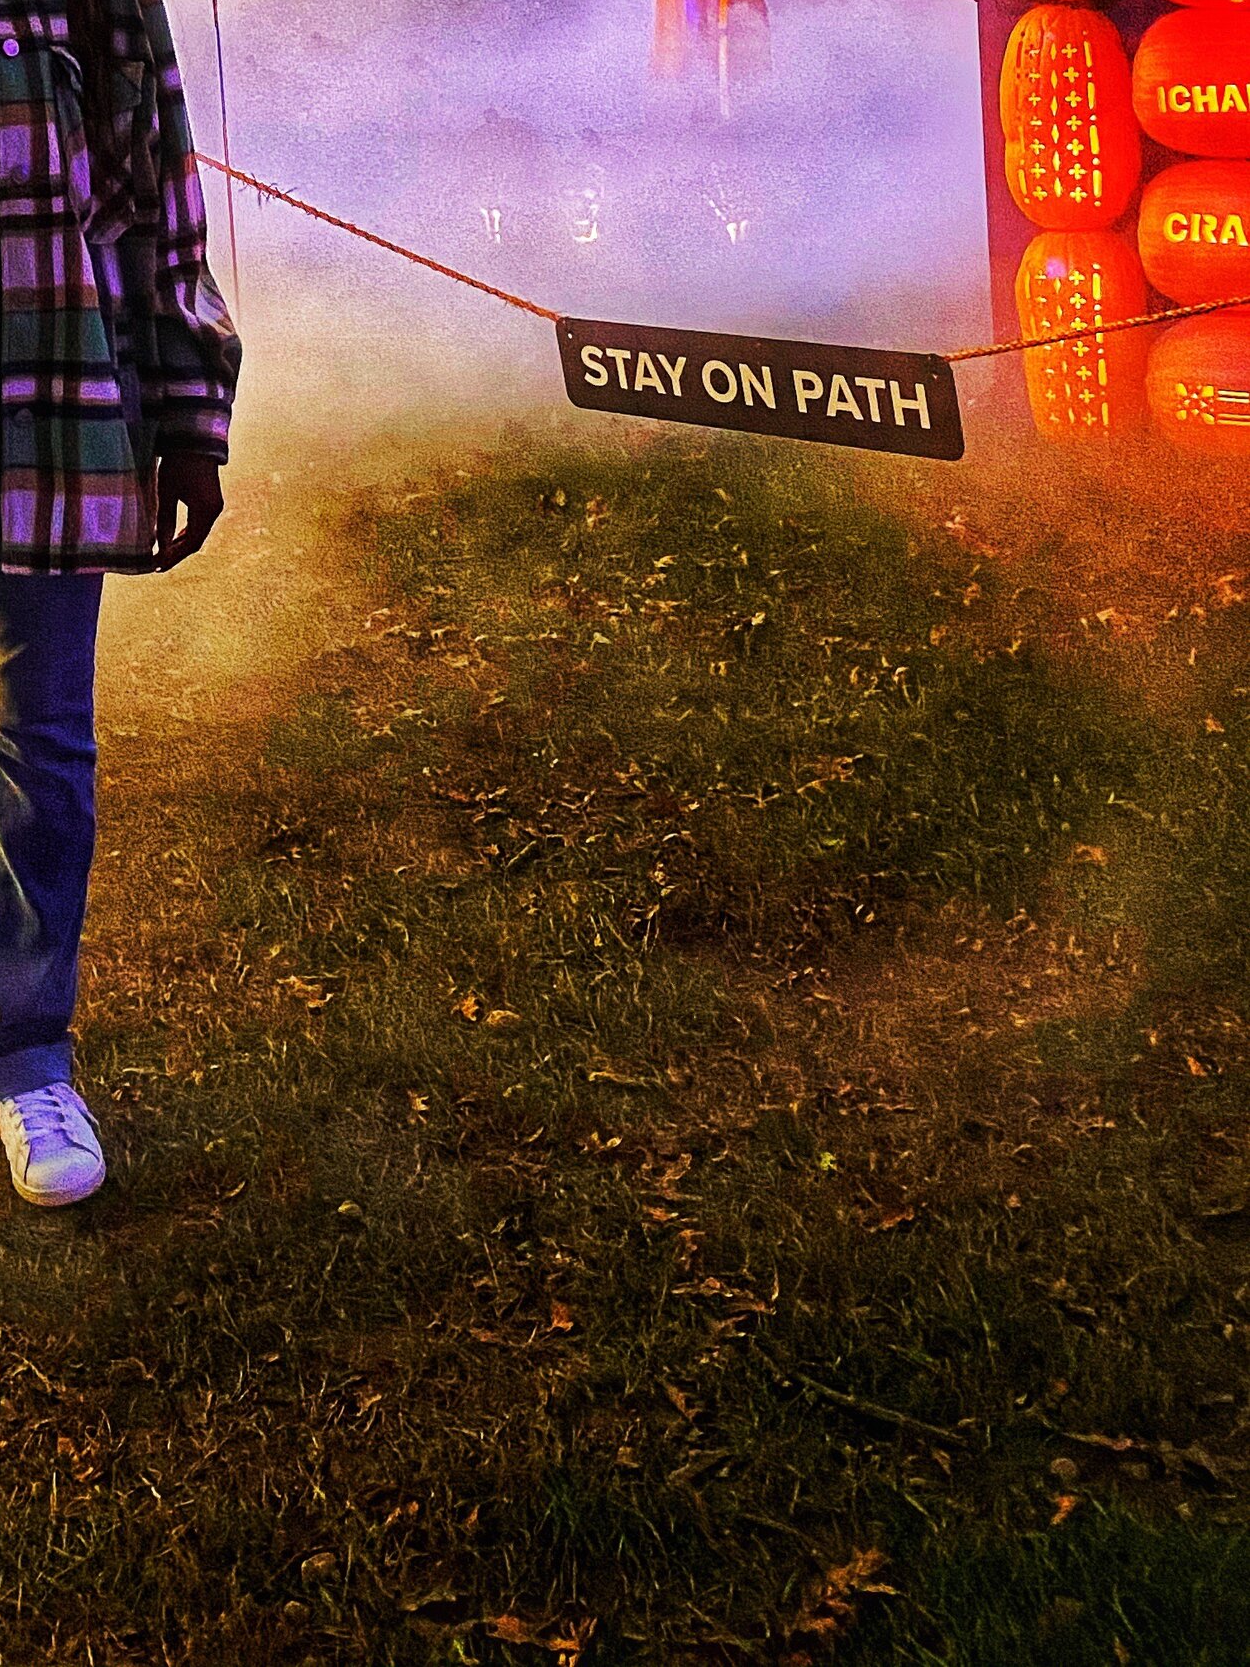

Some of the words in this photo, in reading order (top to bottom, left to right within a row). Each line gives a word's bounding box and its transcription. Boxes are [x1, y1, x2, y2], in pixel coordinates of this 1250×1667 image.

[1157, 84, 1250, 113] ICHA
[579, 344, 687, 397] STAY
[701, 359, 776, 409] ON
[792, 369, 931, 429] PATH
